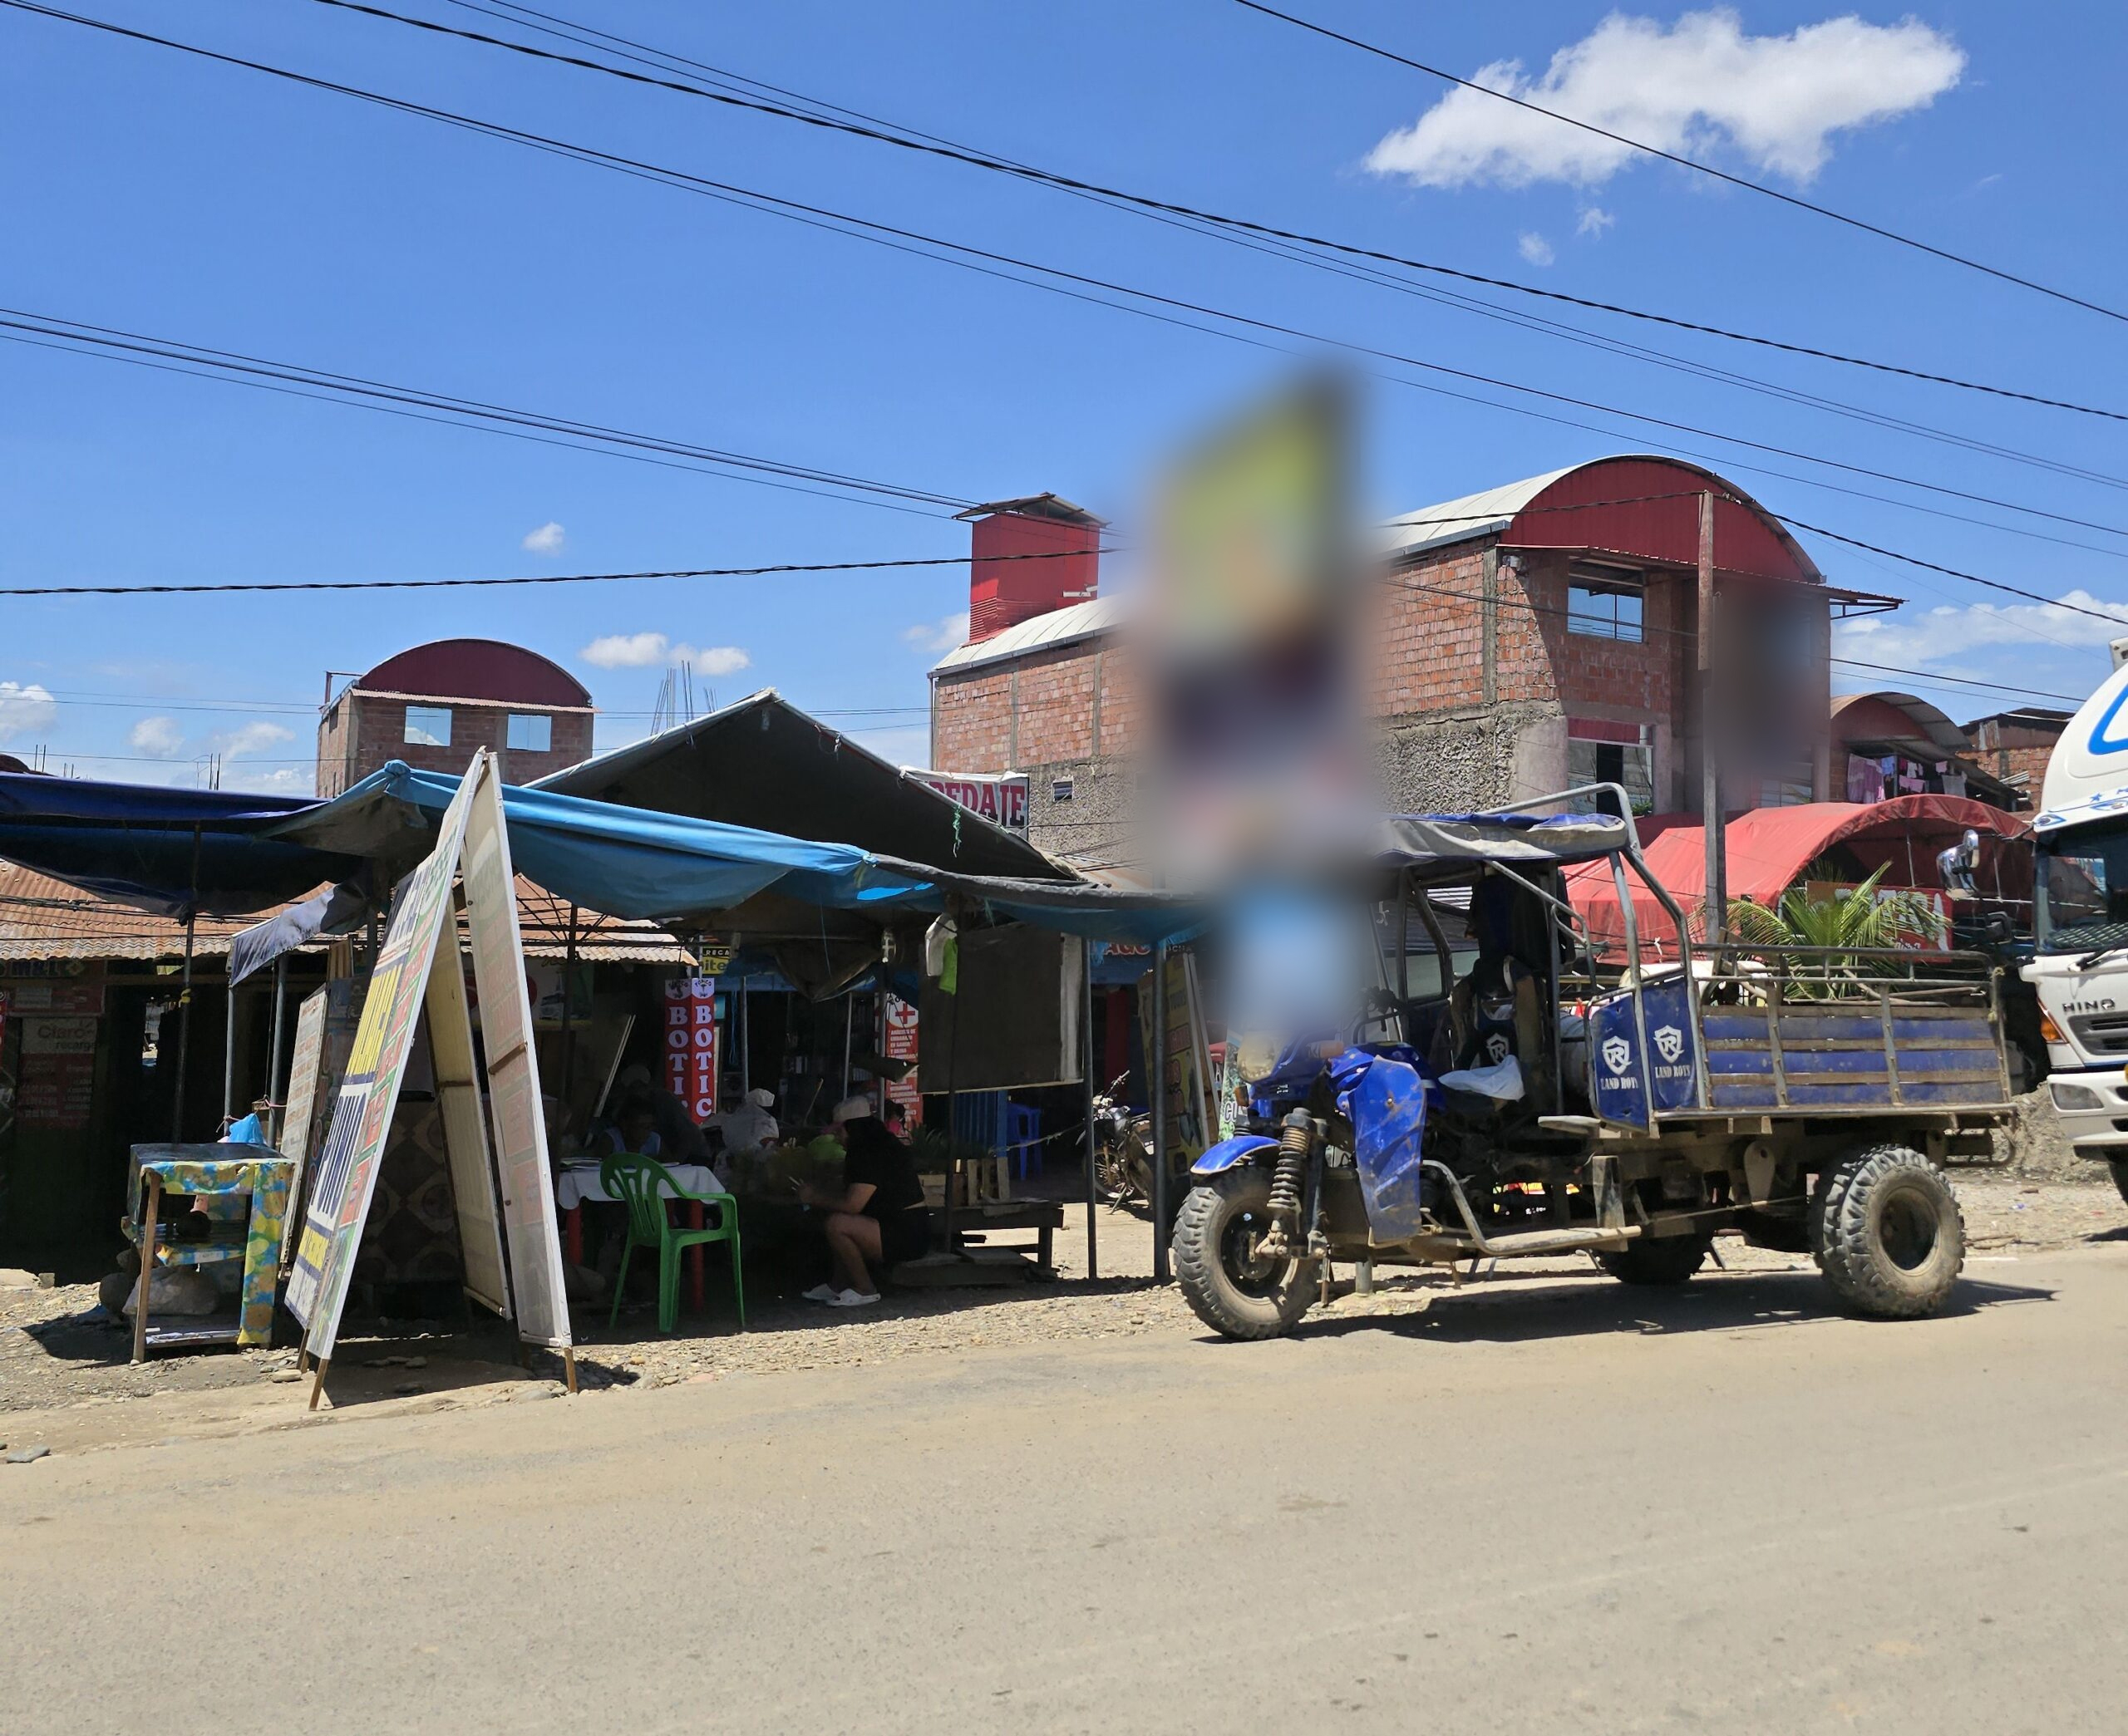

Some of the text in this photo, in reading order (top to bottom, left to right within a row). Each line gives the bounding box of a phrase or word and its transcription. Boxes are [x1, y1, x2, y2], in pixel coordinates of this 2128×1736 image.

[2062, 998, 2116, 1012] HINO
[38, 1025, 85, 1039] Claro
[668, 1006, 689, 1108] BOTI
[1655, 1065, 1672, 1079] LAND
[1601, 1077, 1620, 1090] LAND
[310, 1093, 367, 1219] PUNO
